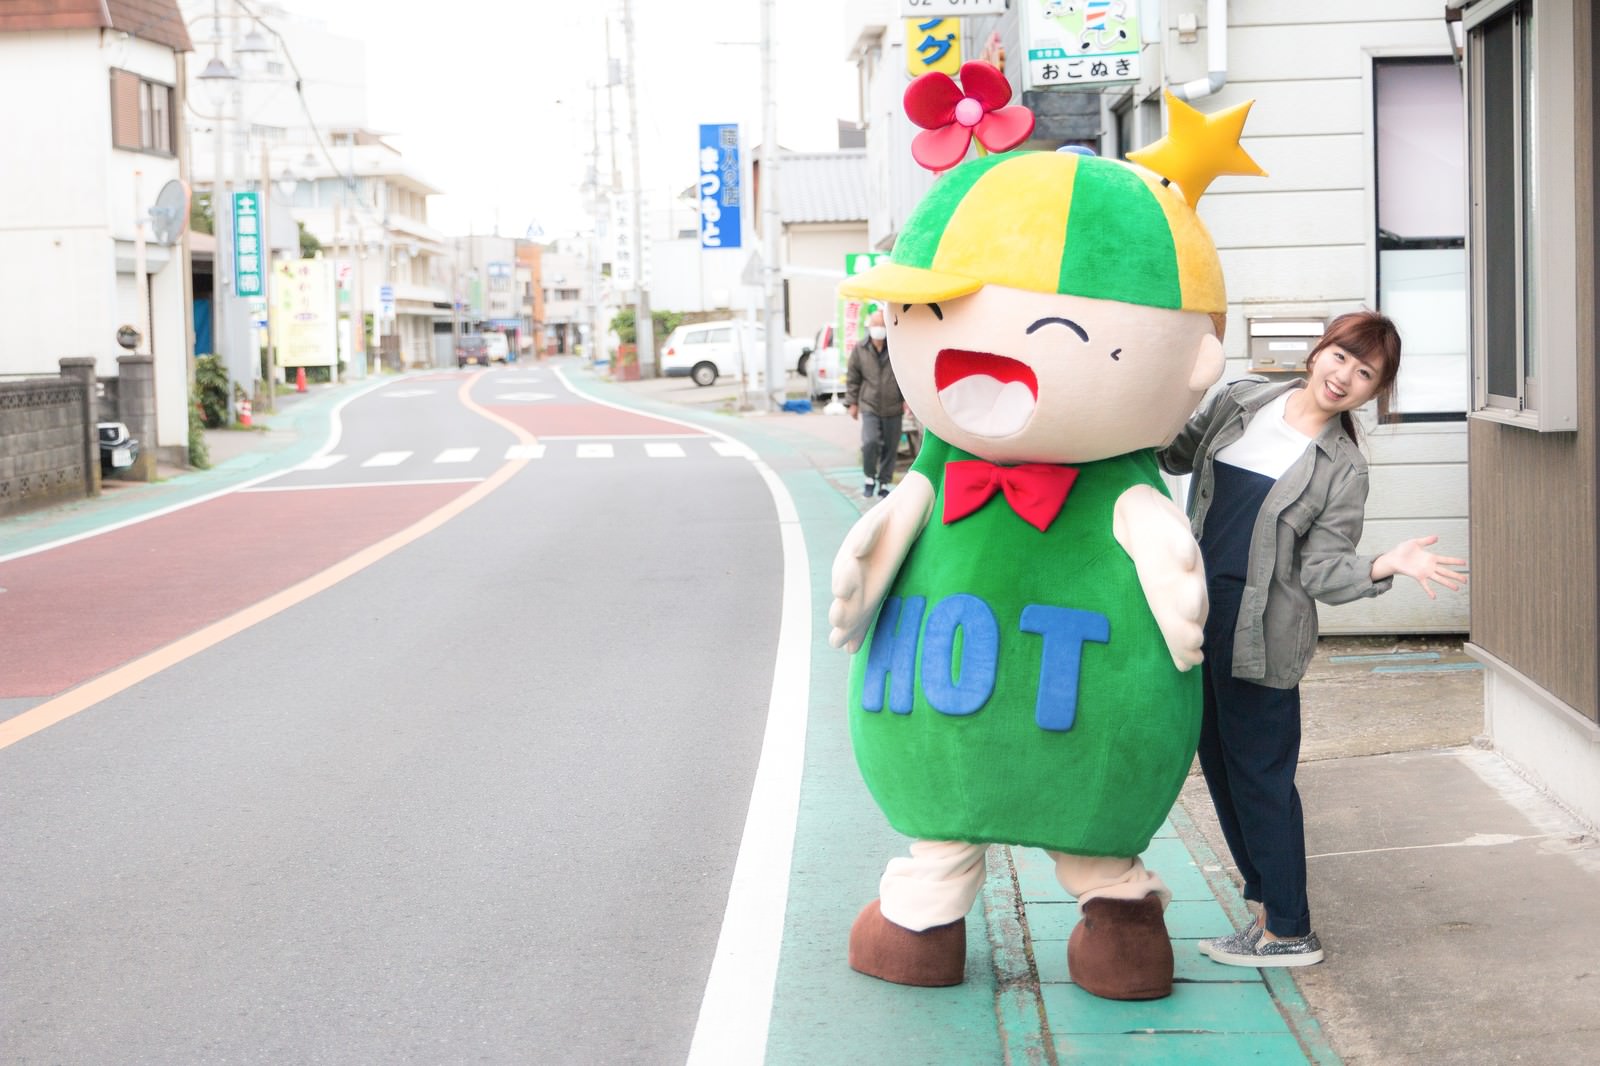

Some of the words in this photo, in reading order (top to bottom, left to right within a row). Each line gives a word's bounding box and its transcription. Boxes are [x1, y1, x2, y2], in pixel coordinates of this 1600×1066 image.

[1042, 58, 1131, 80] おごぬき
[700, 145, 721, 248] まつもと
[861, 593, 1111, 732] HOT
